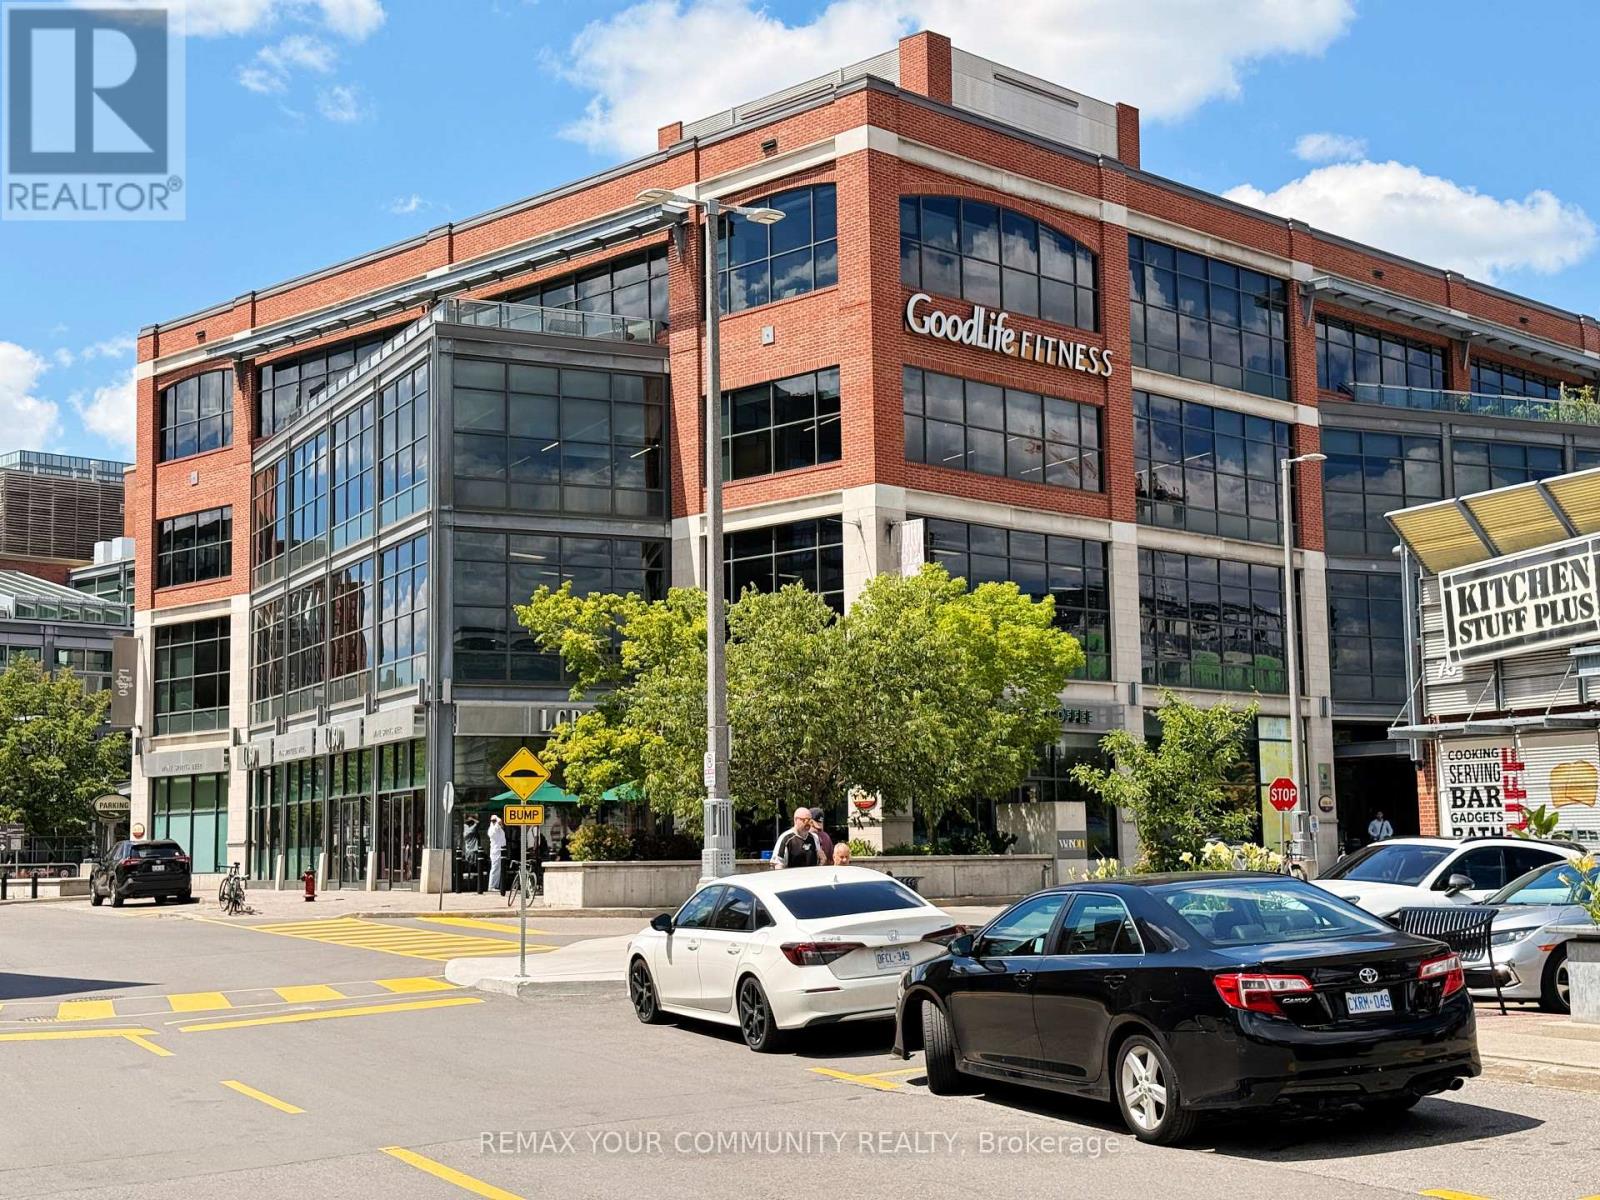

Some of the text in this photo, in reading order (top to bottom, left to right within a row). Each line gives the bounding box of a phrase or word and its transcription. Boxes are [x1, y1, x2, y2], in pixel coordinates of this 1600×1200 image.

[906, 293, 1113, 377] GoodLife FITNESS
[1457, 556, 1590, 617] KITCHEN
[1459, 593, 1594, 644] STUFF PLUS
[1448, 748, 1499, 760] COOKING
[1449, 762, 1501, 784] SERVING
[1271, 788, 1297, 801] STOP
[1451, 786, 1503, 809] BAR
[99, 801, 130, 809] PARKING
[509, 809, 539, 820] BUMP
[1451, 811, 1504, 824] GADGETS
